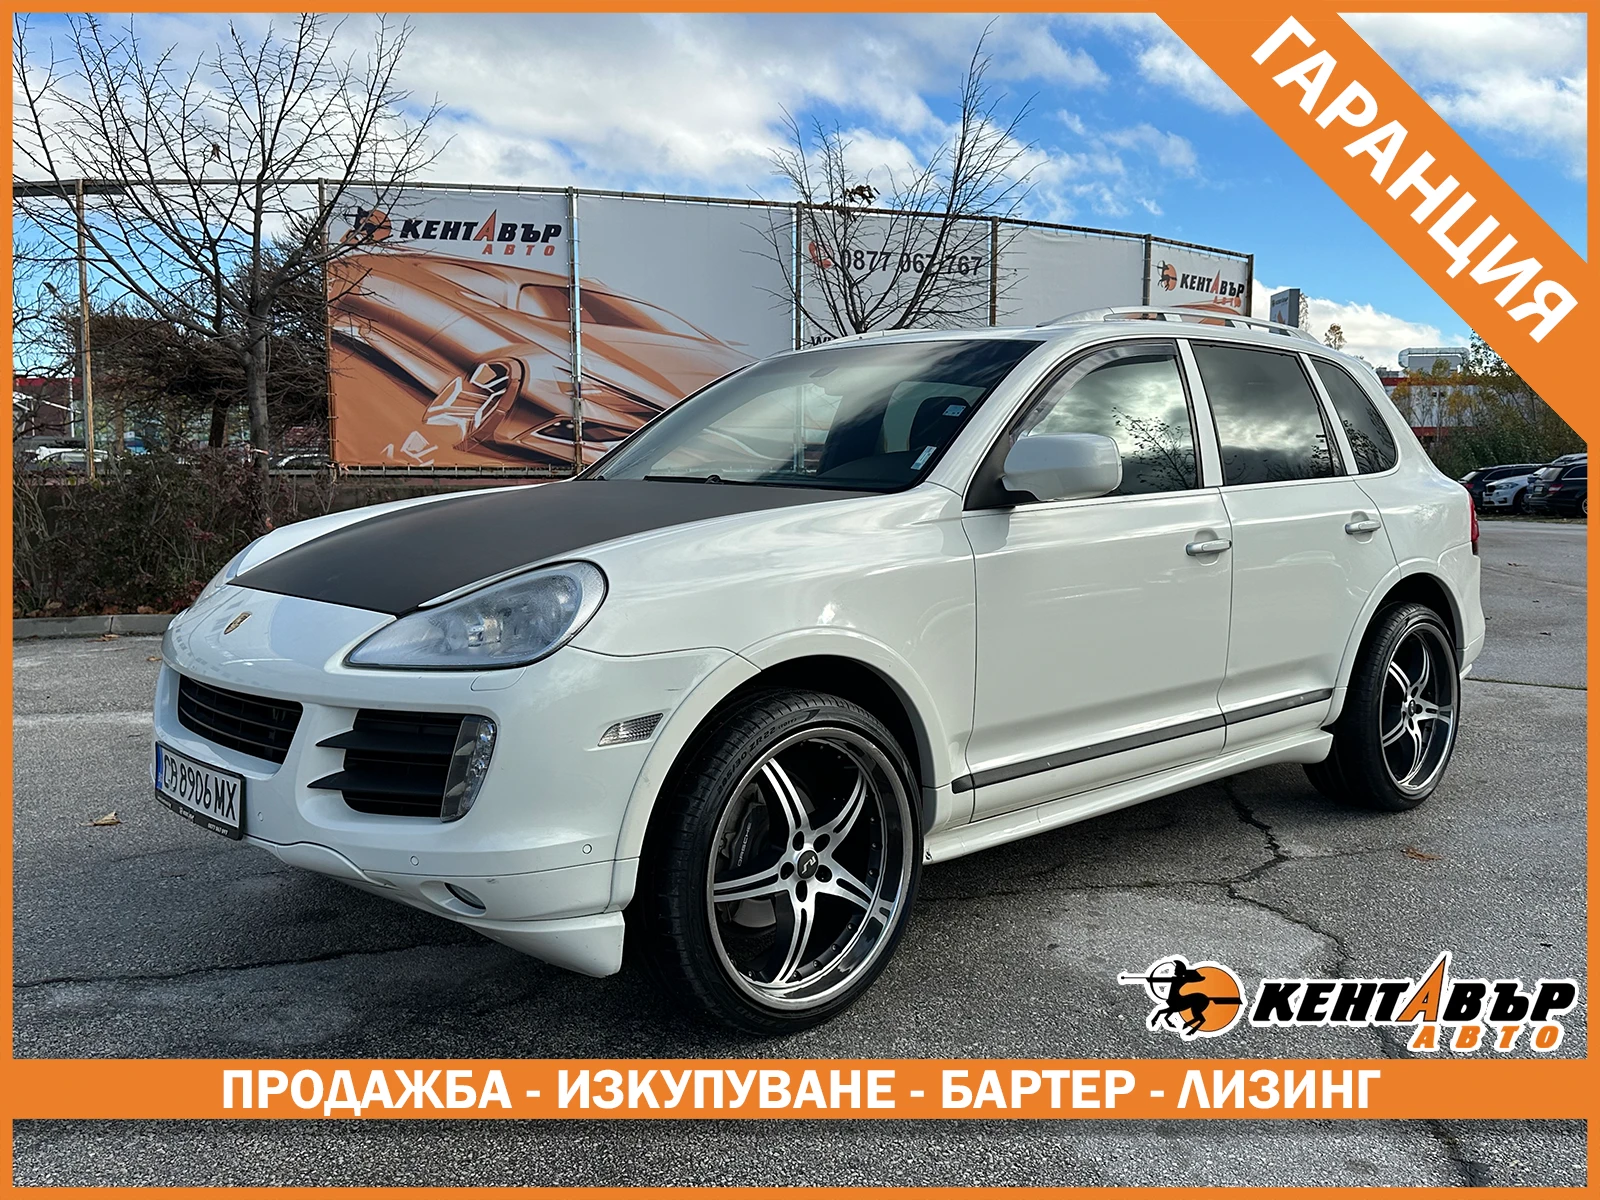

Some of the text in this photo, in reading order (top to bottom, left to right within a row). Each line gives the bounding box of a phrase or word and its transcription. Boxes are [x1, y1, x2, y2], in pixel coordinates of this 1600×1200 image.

[400, 209, 562, 243] КЕНТАВЪР
[482, 244, 556, 256] АВТО
[842, 249, 891, 271] 0877
[1180, 269, 1245, 298] КЕНТАВЪР
